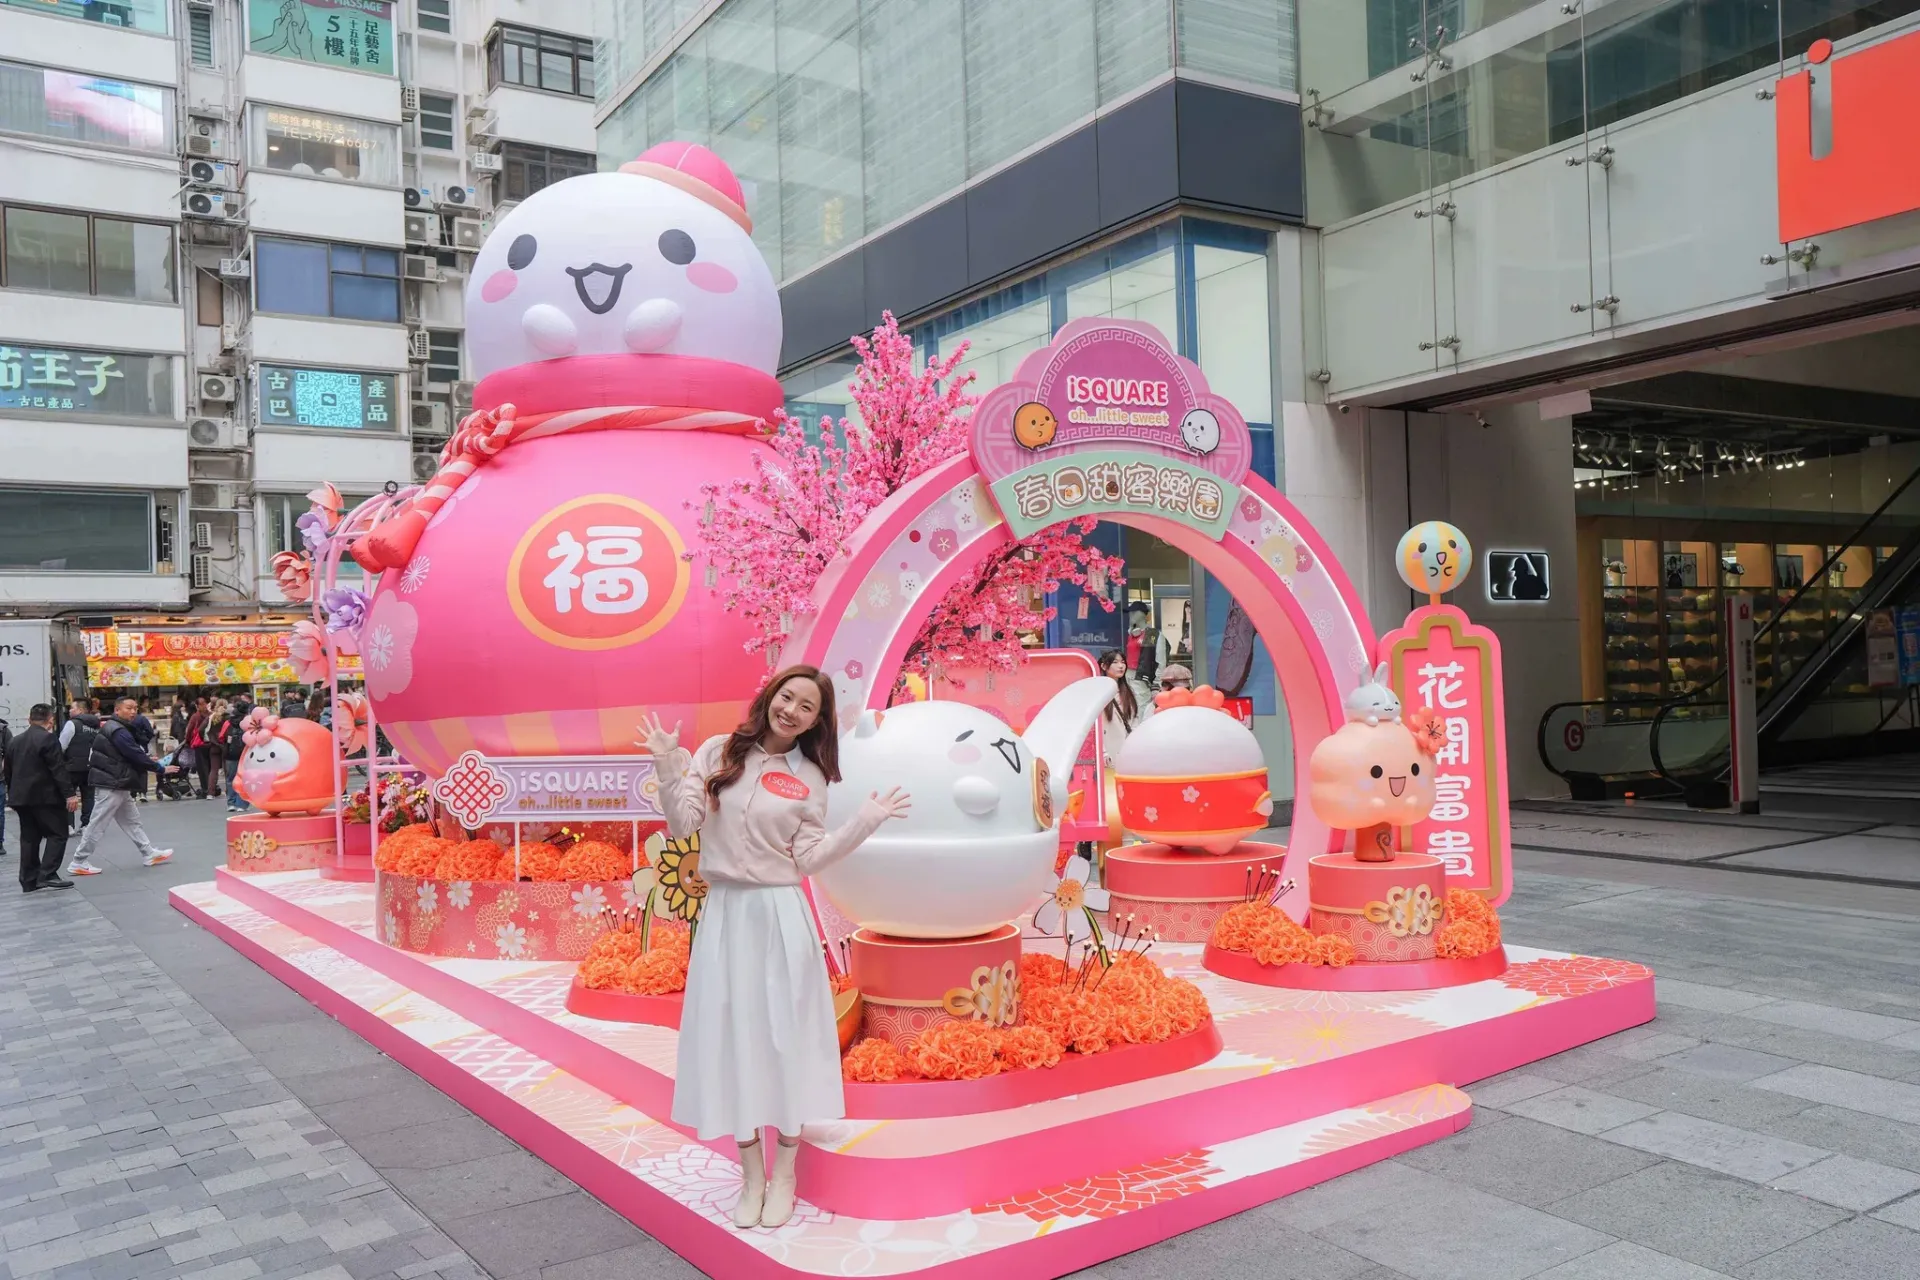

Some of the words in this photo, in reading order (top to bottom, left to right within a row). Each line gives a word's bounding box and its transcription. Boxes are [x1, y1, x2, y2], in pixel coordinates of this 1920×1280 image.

[333, 0, 383, 13] MASSAGE
[324, 15, 345, 58] 5樓
[364, 20, 380, 64] 足藝舍
[18, 395, 74, 409] 古巴產品
[267, 372, 291, 417] 古巴
[367, 380, 388, 422] 產品
[1068, 376, 1168, 405] iSQUARE
[1069, 408, 1128, 424] oh...little
[1132, 411, 1169, 426] sweet
[1014, 461, 1223, 522] 春日甜蜜樂園
[543, 526, 649, 614] 福
[520, 771, 628, 793] iSQUARE
[1417, 661, 1475, 877] 花開富貴
[518, 795, 582, 810] oh...little
[587, 795, 628, 810] sweet
